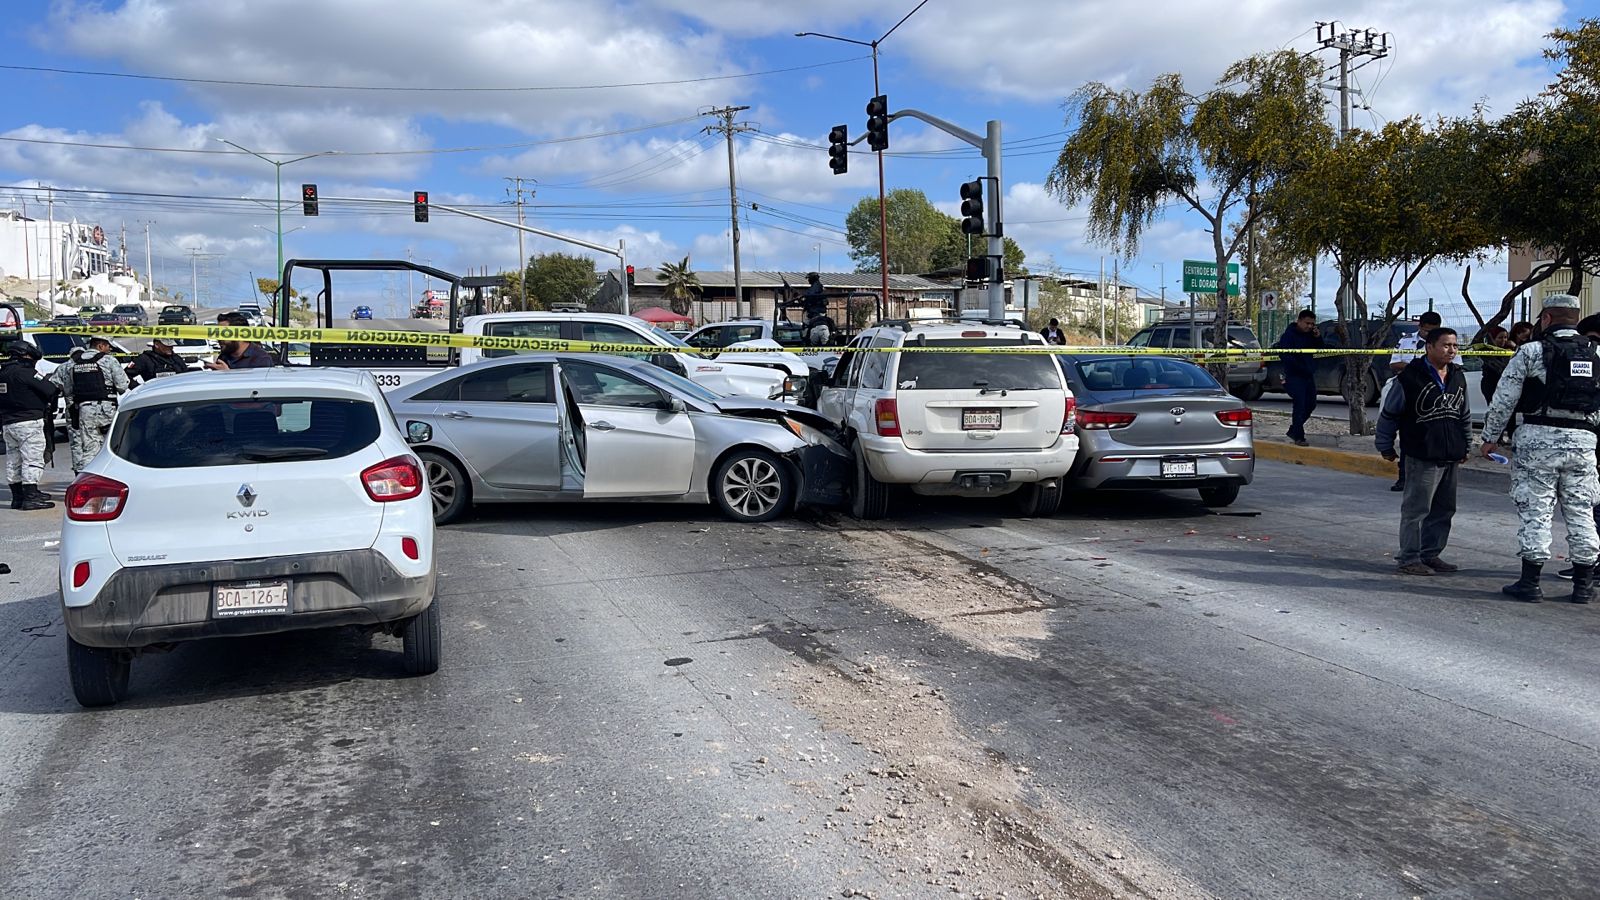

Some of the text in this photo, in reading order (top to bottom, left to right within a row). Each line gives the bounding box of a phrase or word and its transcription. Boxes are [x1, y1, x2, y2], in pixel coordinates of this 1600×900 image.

[1185, 266, 1203, 275] CENTRO
[1203, 267, 1210, 276] DE
[1191, 278, 1198, 288] EL
[374, 374, 401, 386] 333
[226, 510, 269, 519] KWID
[127, 554, 168, 562] RENAULT
[218, 588, 288, 607] BCA-126-A
